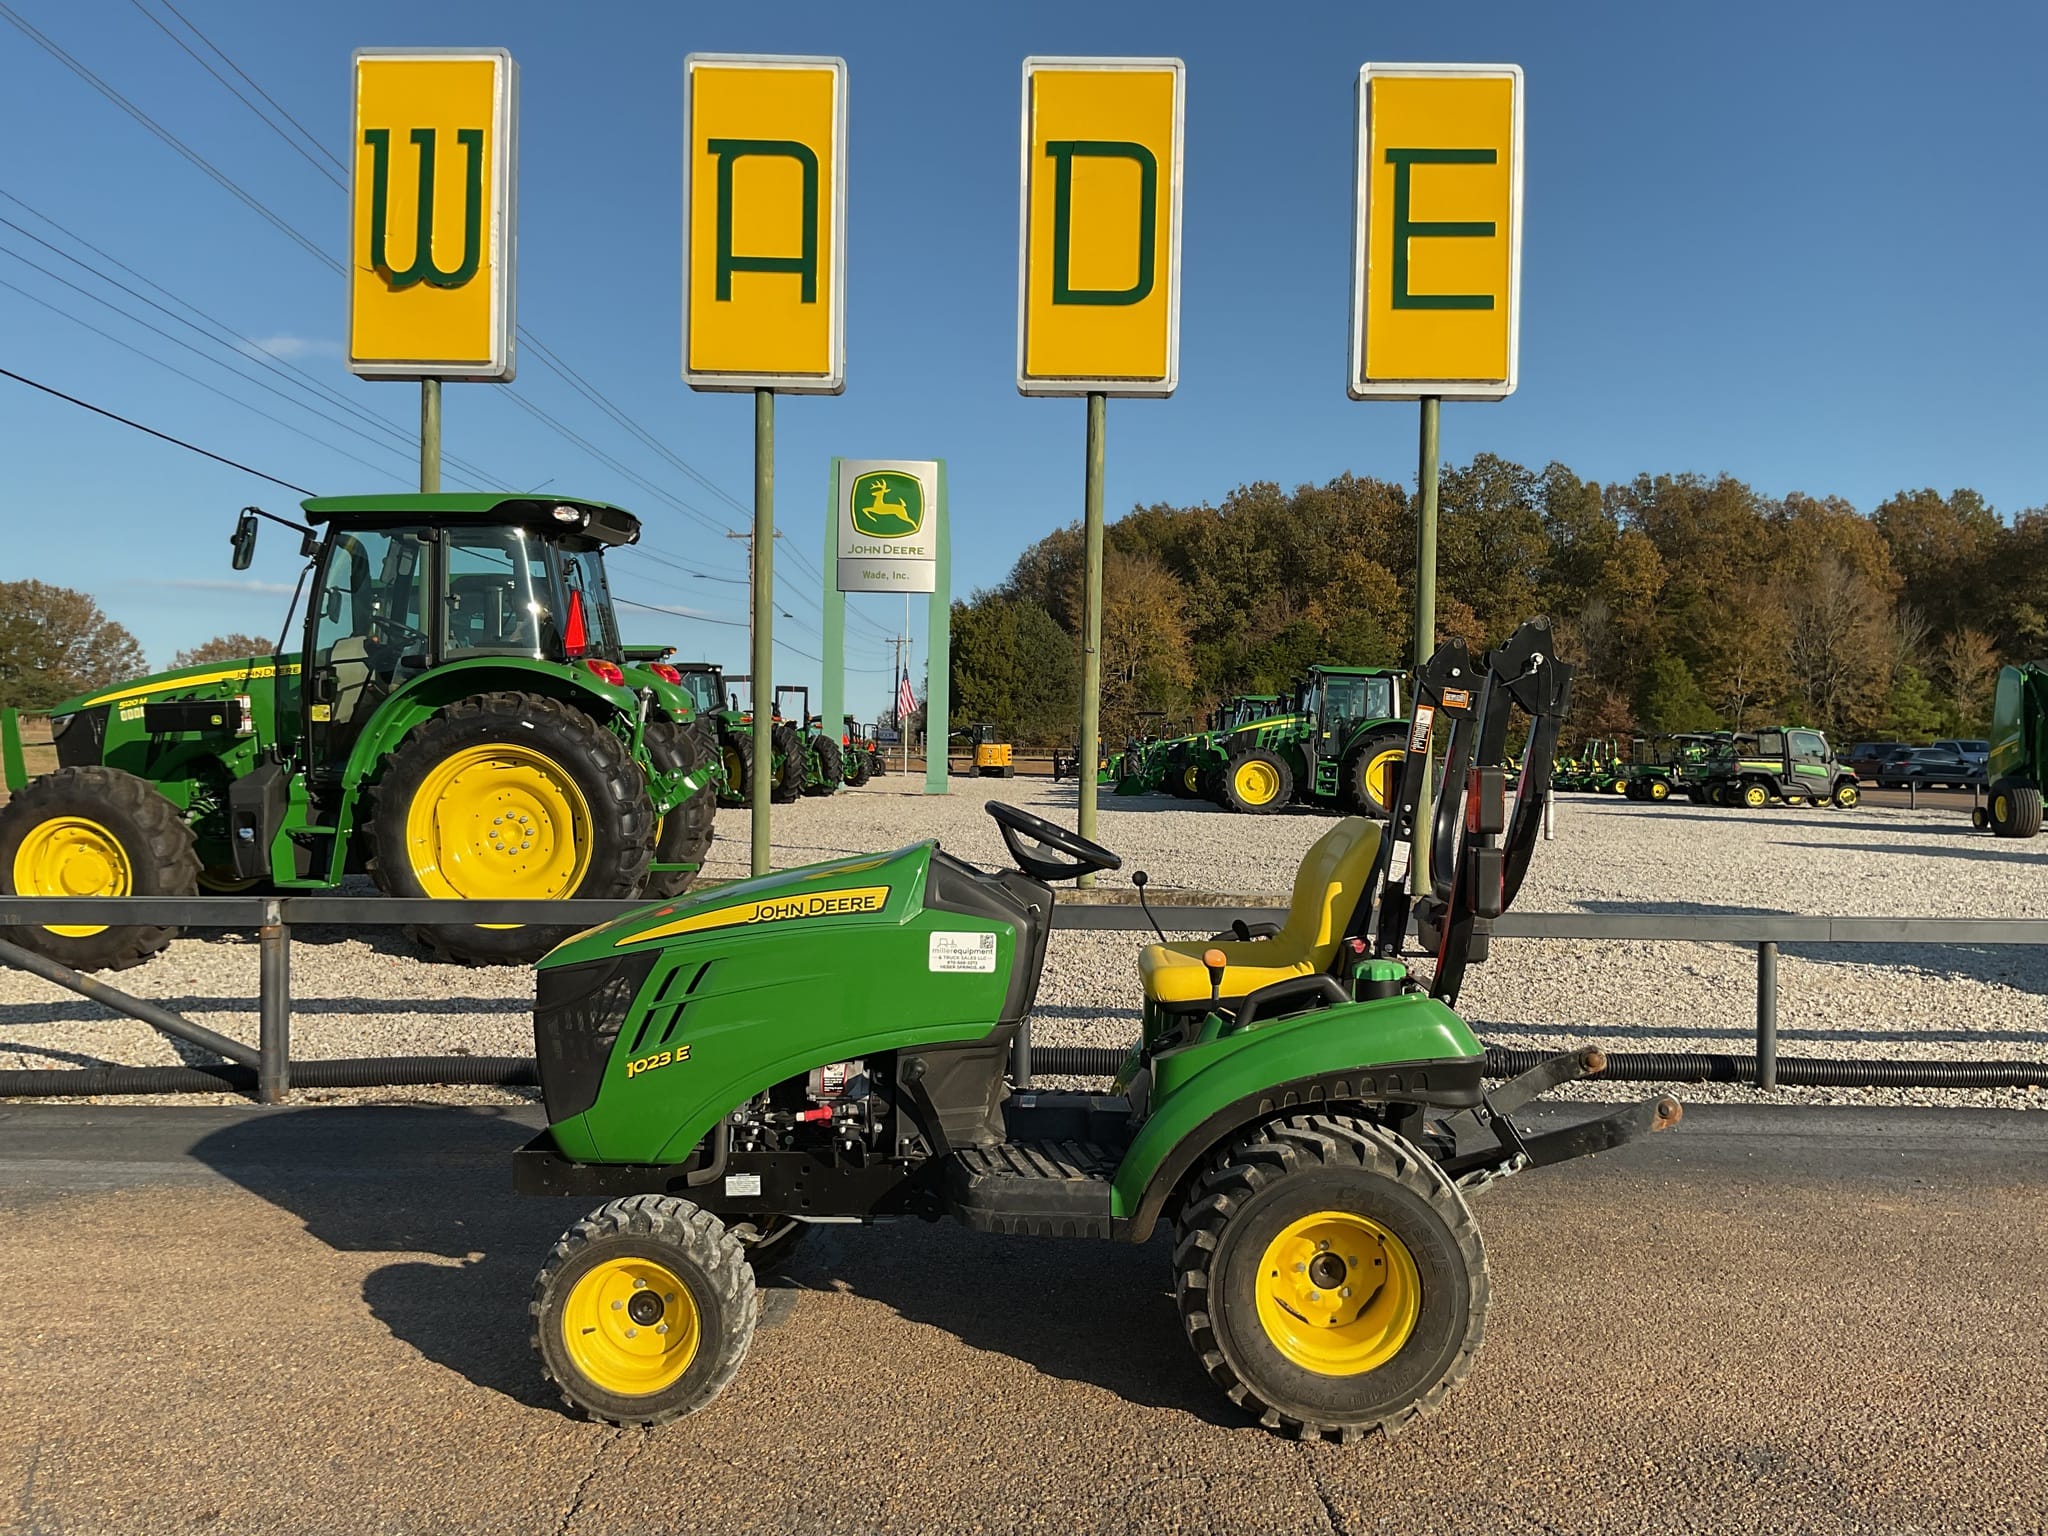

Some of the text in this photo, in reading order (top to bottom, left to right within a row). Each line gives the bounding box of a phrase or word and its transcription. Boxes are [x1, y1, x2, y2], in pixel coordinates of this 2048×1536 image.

[848, 544, 925, 556] JOHN DEERE
[862, 570, 910, 581] Wade, Inc.
[234, 670, 262, 680] JOHN
[748, 896, 876, 922] JOHN DEERE
[626, 1045, 691, 1079] 1023 E
